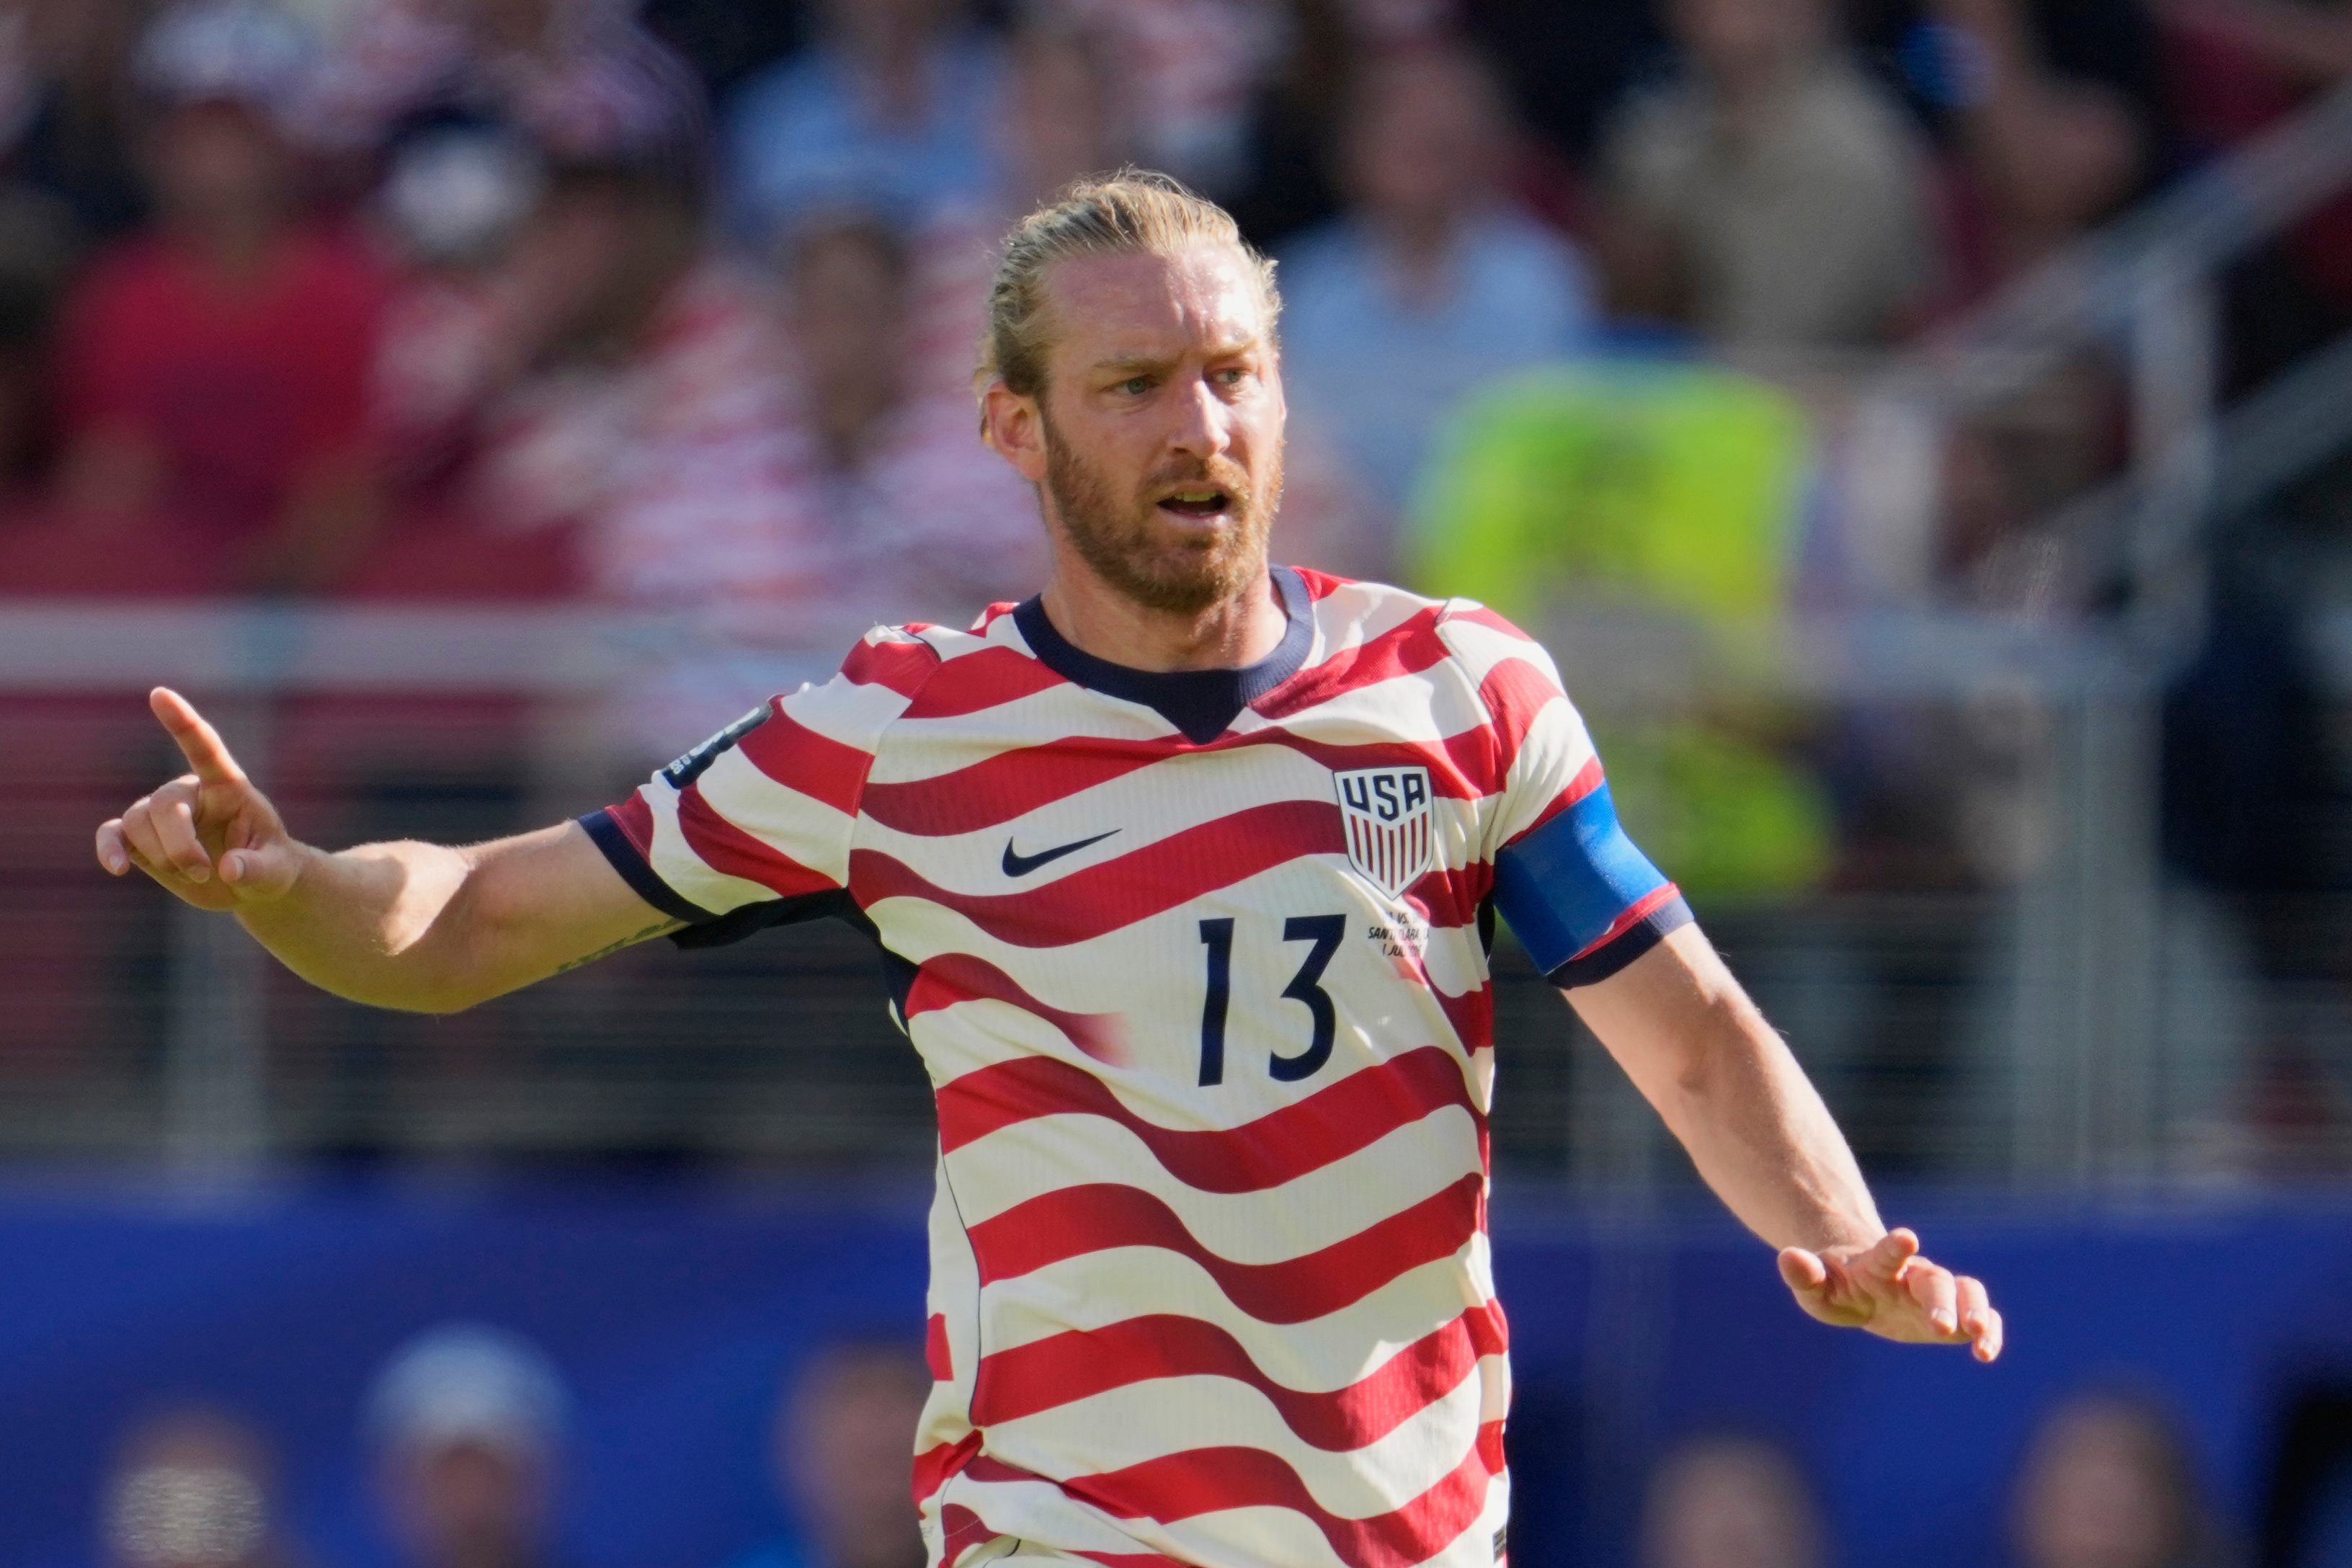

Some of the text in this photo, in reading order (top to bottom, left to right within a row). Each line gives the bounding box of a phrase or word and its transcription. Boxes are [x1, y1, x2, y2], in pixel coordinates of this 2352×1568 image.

[1342, 773, 1426, 821] USA
[1396, 913, 1409, 924] VS.
[1198, 914, 1347, 1087] 13
